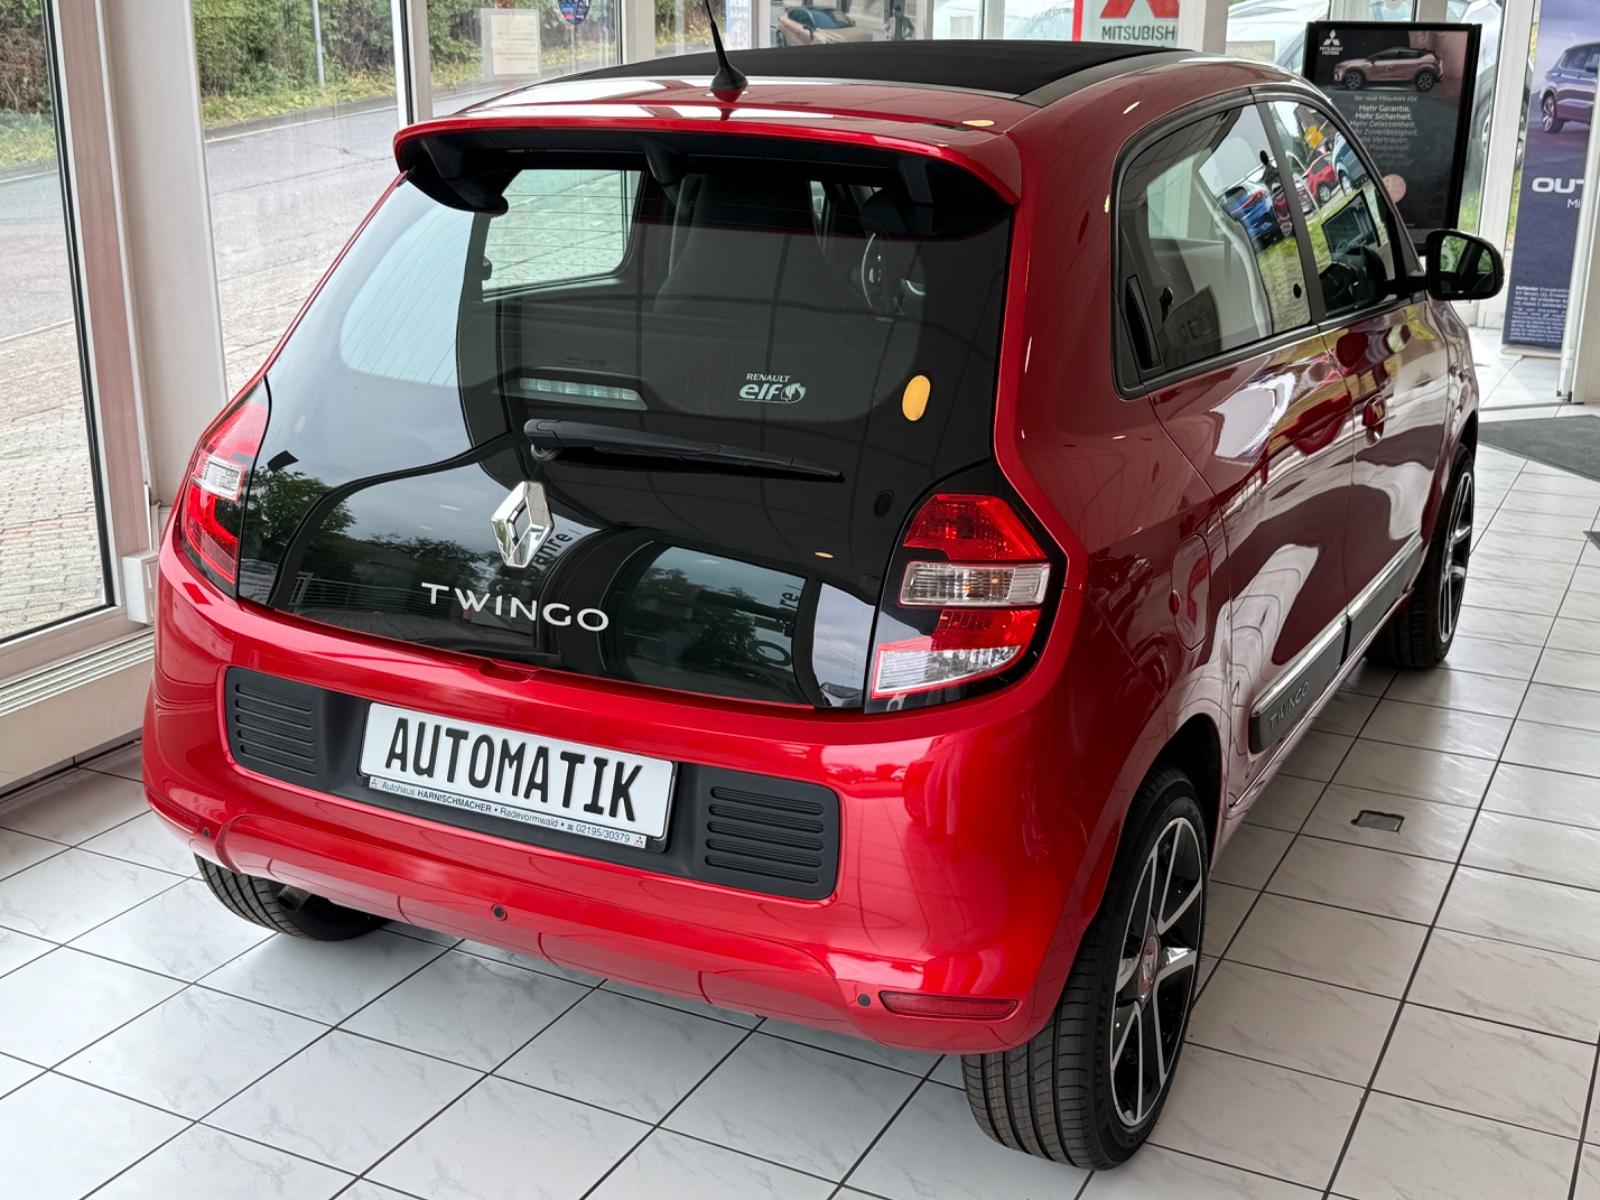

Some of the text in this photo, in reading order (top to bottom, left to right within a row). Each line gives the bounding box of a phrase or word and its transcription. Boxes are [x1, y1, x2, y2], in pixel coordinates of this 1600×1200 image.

[745, 372, 792, 383] RENAULT
[421, 581, 610, 632] TWINGO
[1270, 680, 1310, 729] TWINGO
[385, 717, 643, 822] AUTOMATIK
[381, 780, 631, 843] Autohaus HARNISCHMACHER Radevormwald 02195/30379
